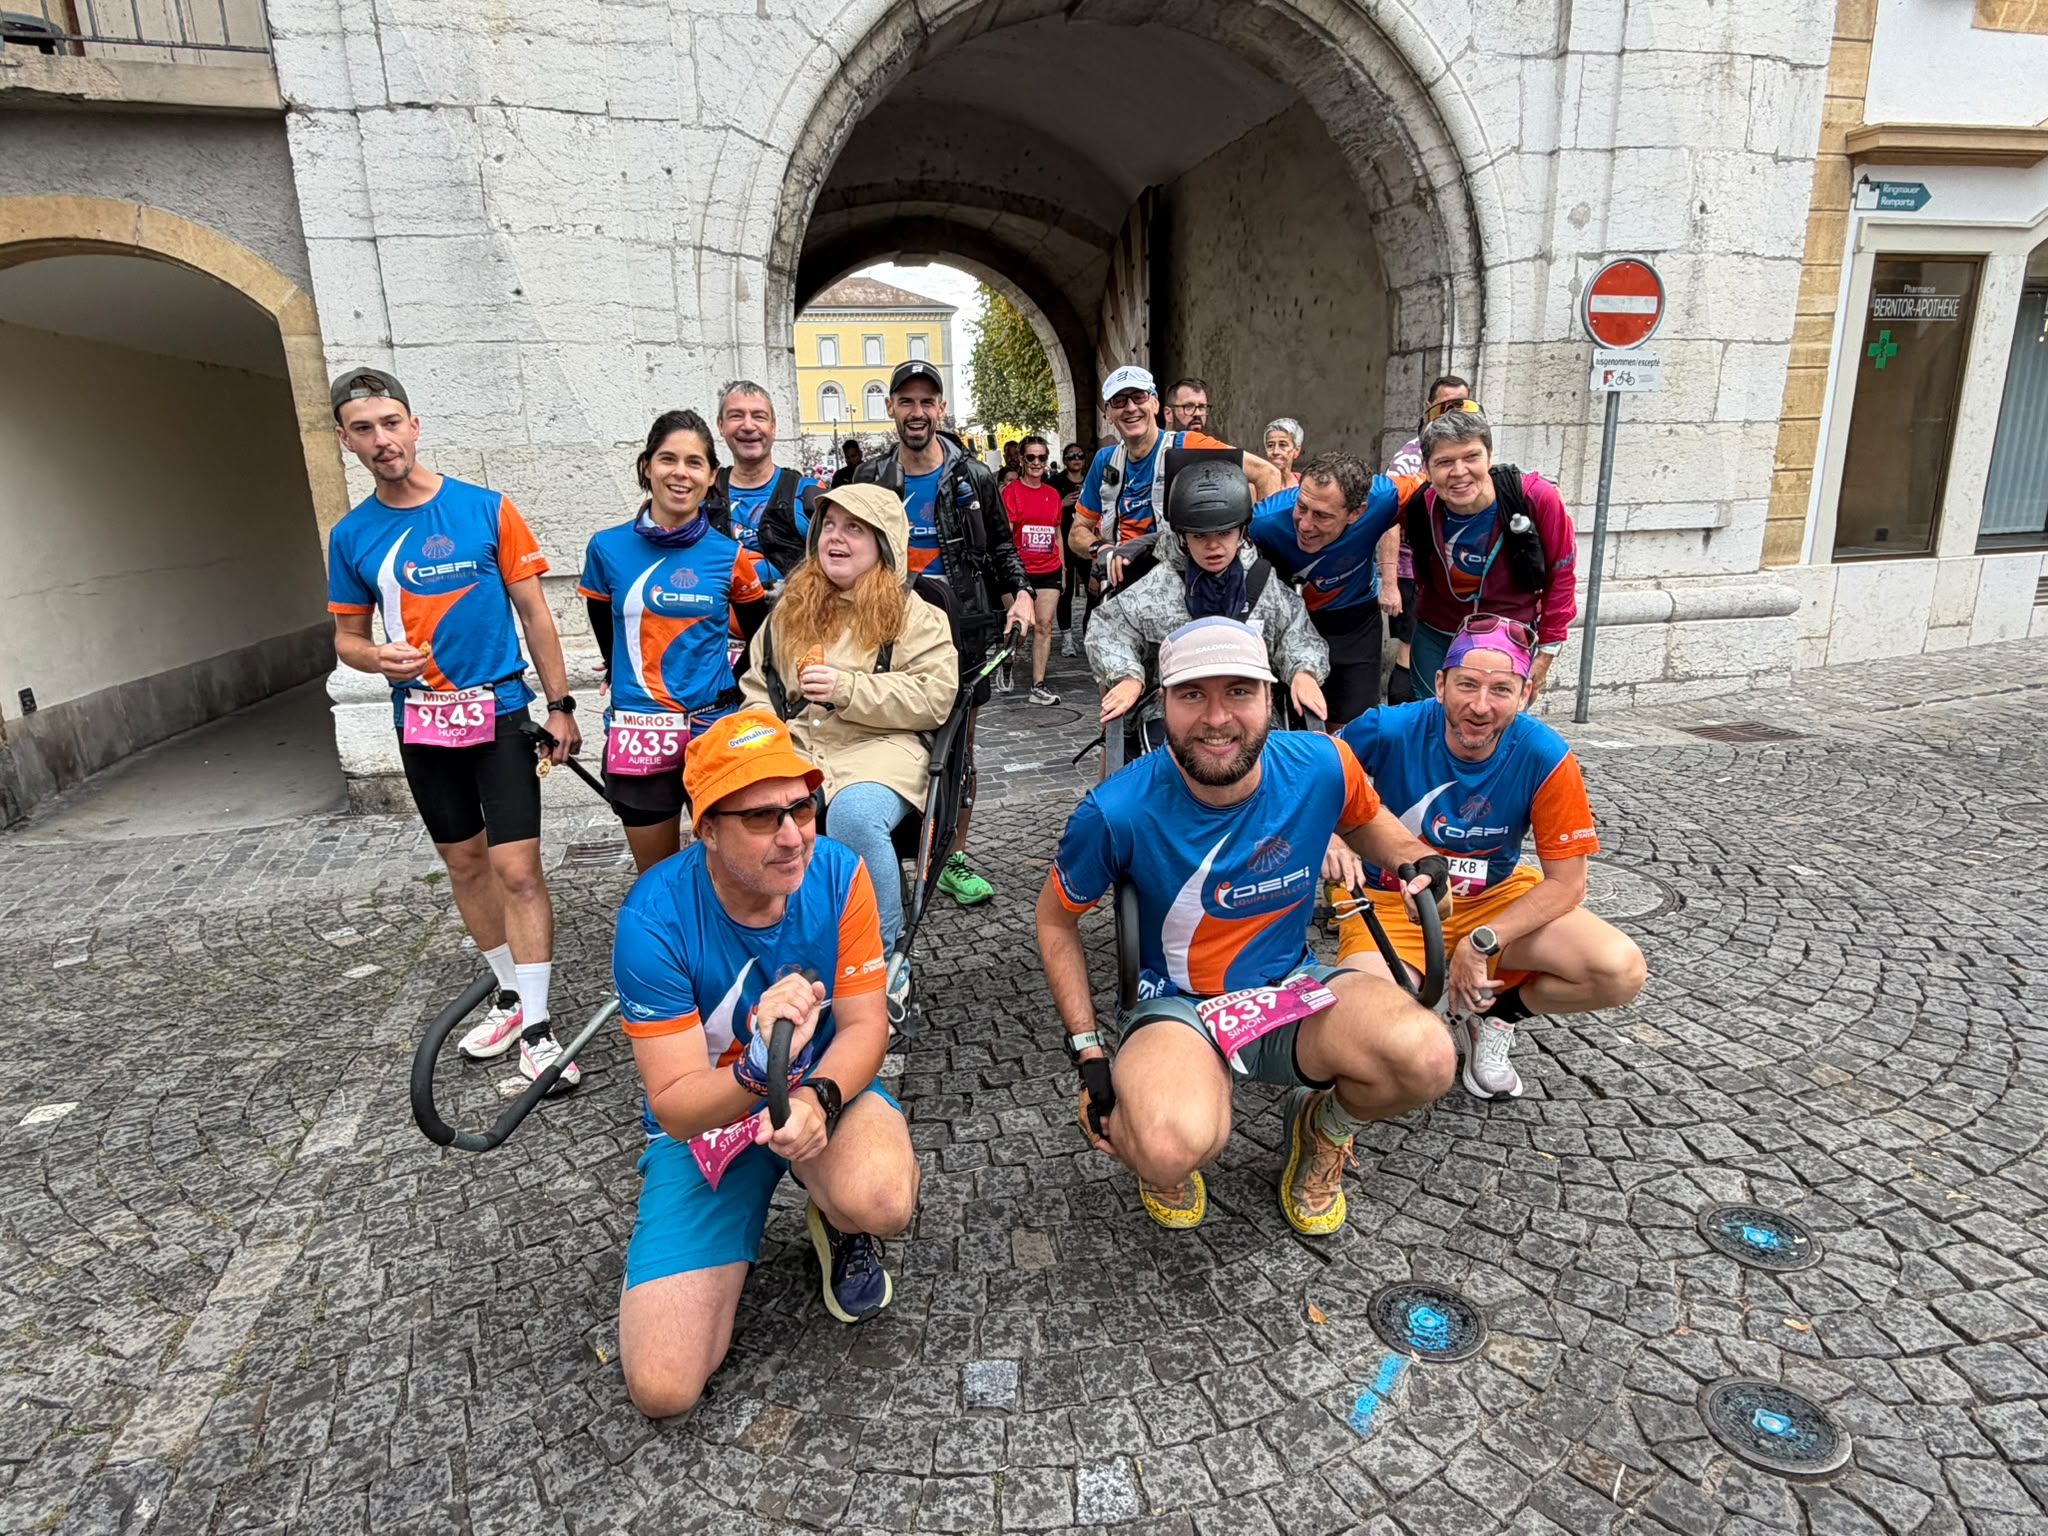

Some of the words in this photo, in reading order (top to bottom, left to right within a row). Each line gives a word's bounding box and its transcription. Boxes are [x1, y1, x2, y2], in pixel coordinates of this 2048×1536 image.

[1873, 298, 1960, 317] BERNTOR-APOTHEKE
[1027, 533, 1052, 545] 1823
[1195, 643, 1241, 654] SALOMON
[423, 690, 478, 702] MIGROS
[417, 702, 485, 729] 9643
[623, 715, 675, 727] MIGROS
[438, 728, 467, 737] HUGO
[729, 729, 775, 747] Ovomaltine
[617, 729, 679, 756] 9635
[628, 756, 662, 765] AURELIE
[1227, 1014, 1267, 1040] SIMON
[719, 1118, 760, 1152] STEPHA
